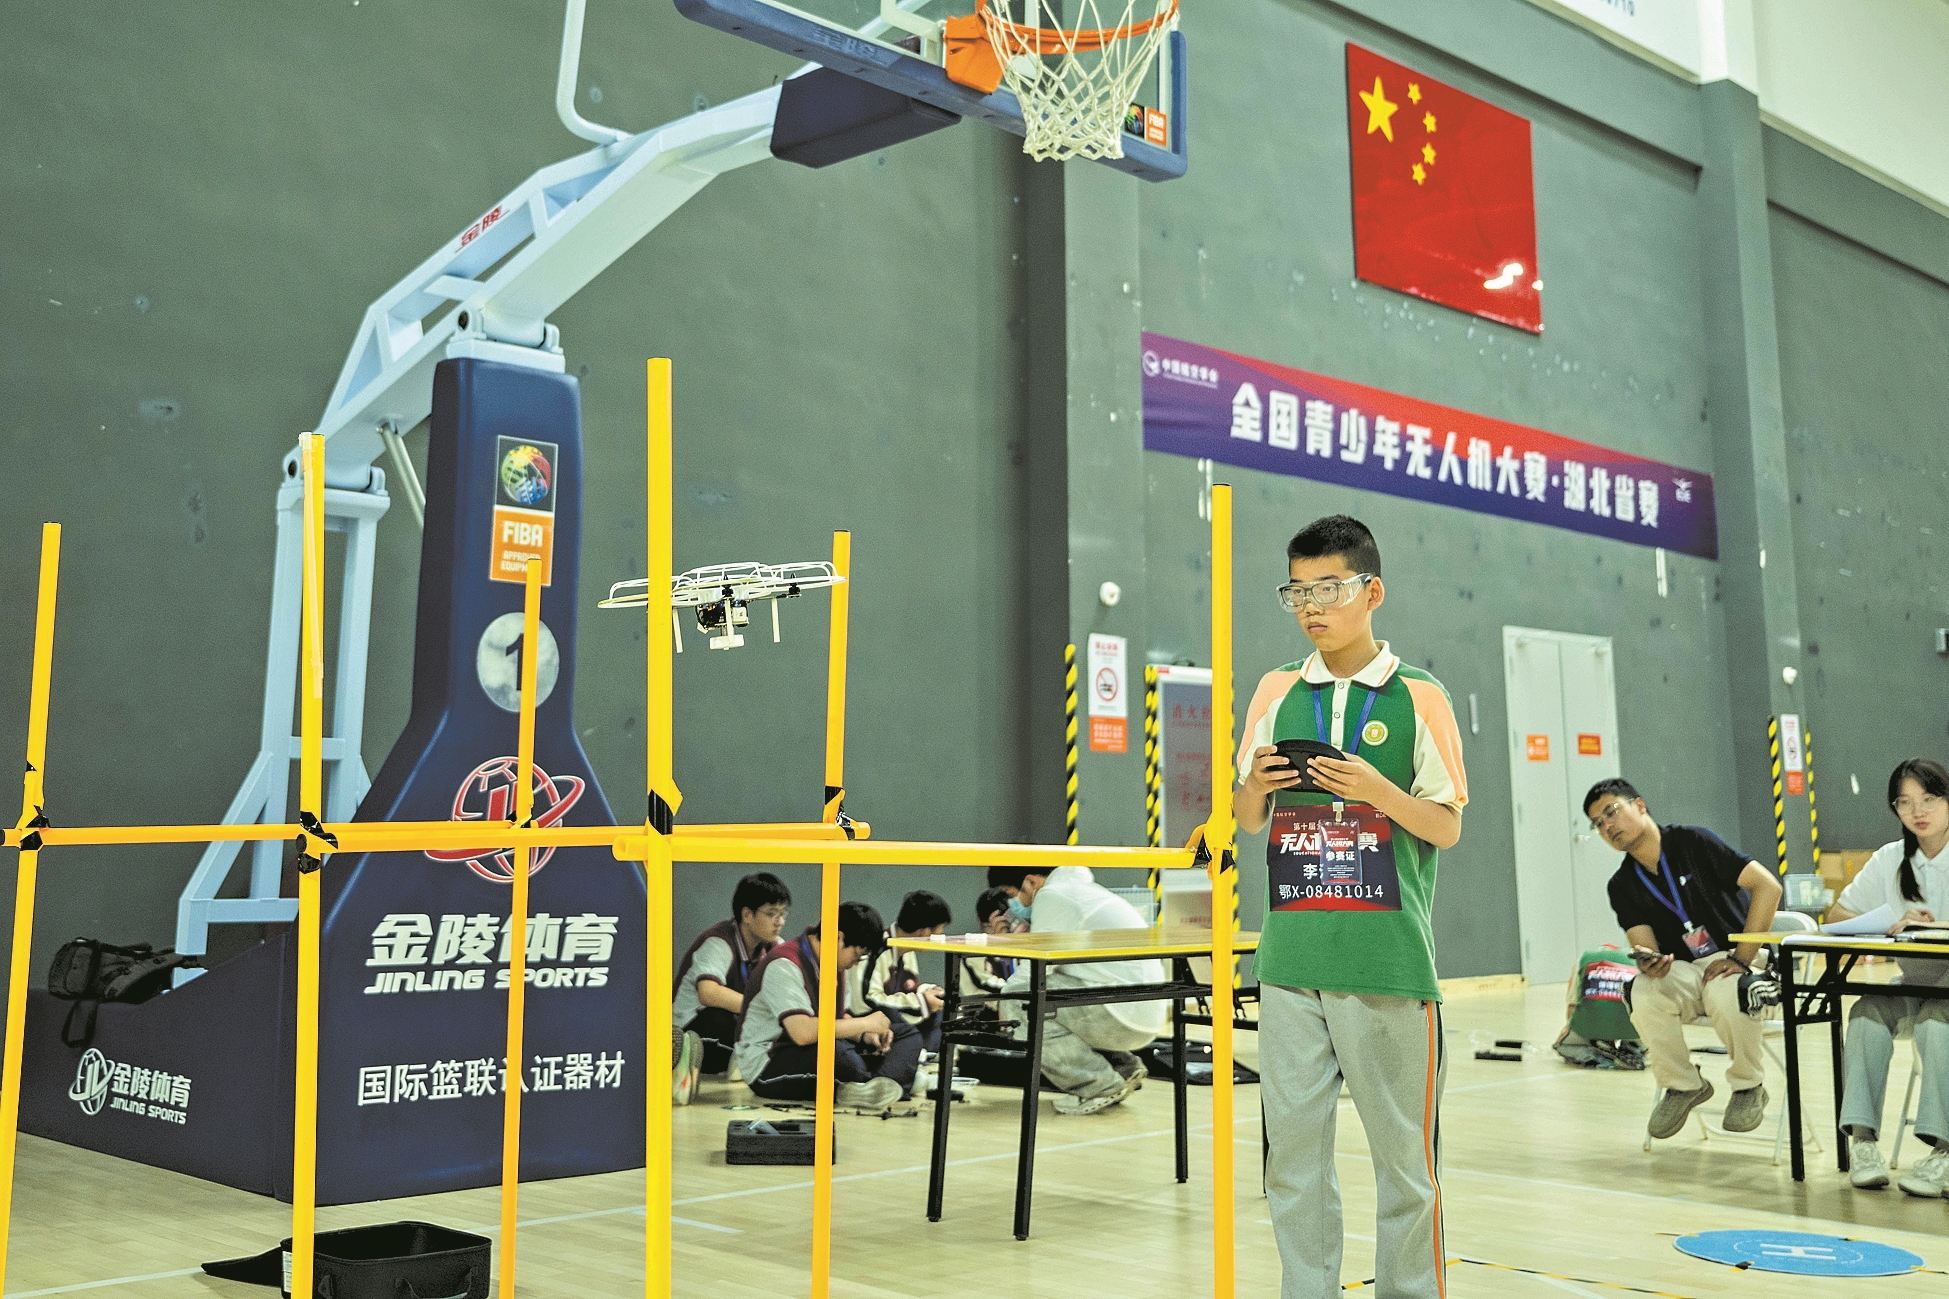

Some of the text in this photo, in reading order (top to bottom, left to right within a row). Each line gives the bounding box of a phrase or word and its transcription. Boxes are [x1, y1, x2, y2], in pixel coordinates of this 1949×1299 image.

[503, 520, 544, 548] FIBA
[506, 633, 525, 691] 1
[1325, 850, 1356, 862] 参赛证
[365, 913, 619, 967] 金陵体育
[363, 969, 486, 994] JINLING
[111, 1062, 192, 1109] 金陵体育
[110, 1096, 187, 1125] JINLING SPORTS
